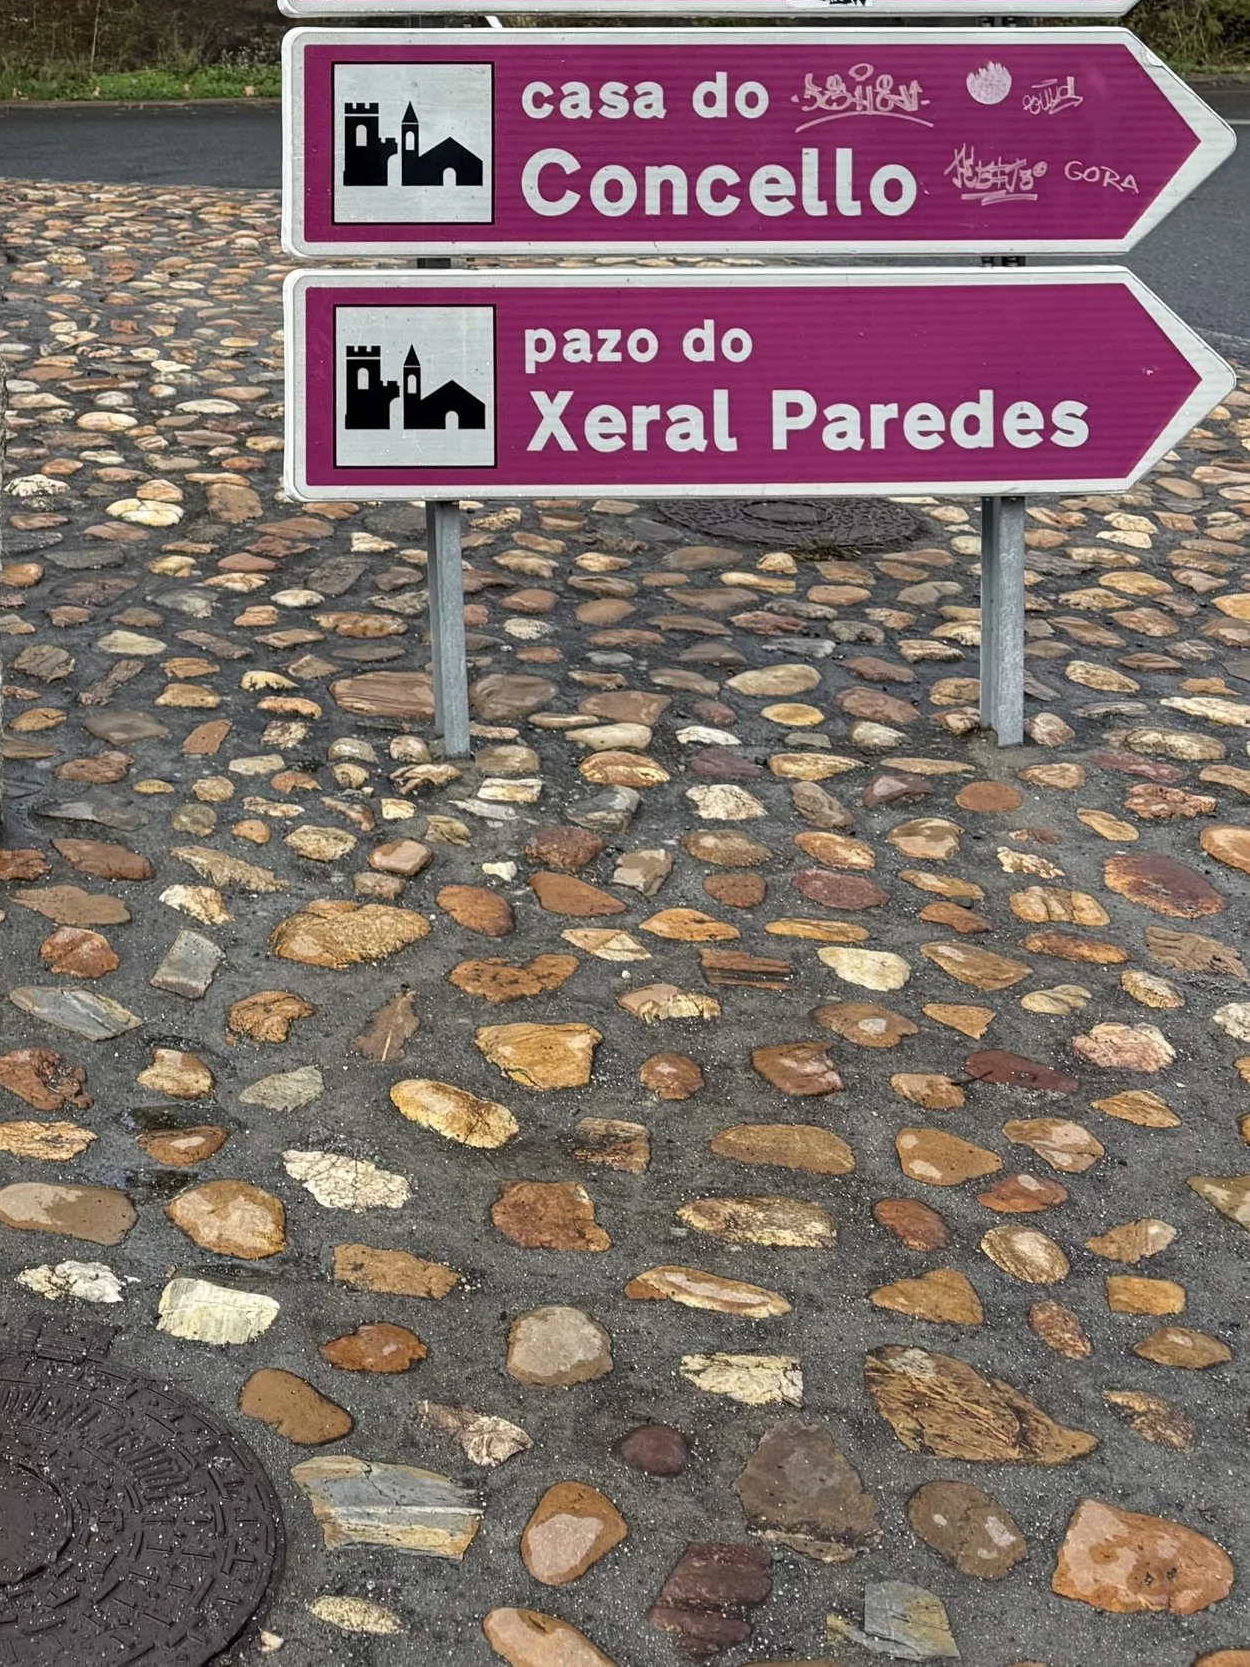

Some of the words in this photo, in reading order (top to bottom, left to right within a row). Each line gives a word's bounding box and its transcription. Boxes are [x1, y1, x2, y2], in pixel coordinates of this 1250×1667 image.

[522, 81, 667, 120] casa
[693, 72, 769, 119] do
[521, 148, 917, 217] Concello
[1064, 160, 1140, 194] GORA
[525, 328, 659, 374] pazo
[683, 320, 753, 363] do
[526, 389, 738, 453] Xeral
[772, 389, 1090, 452] Paredes
